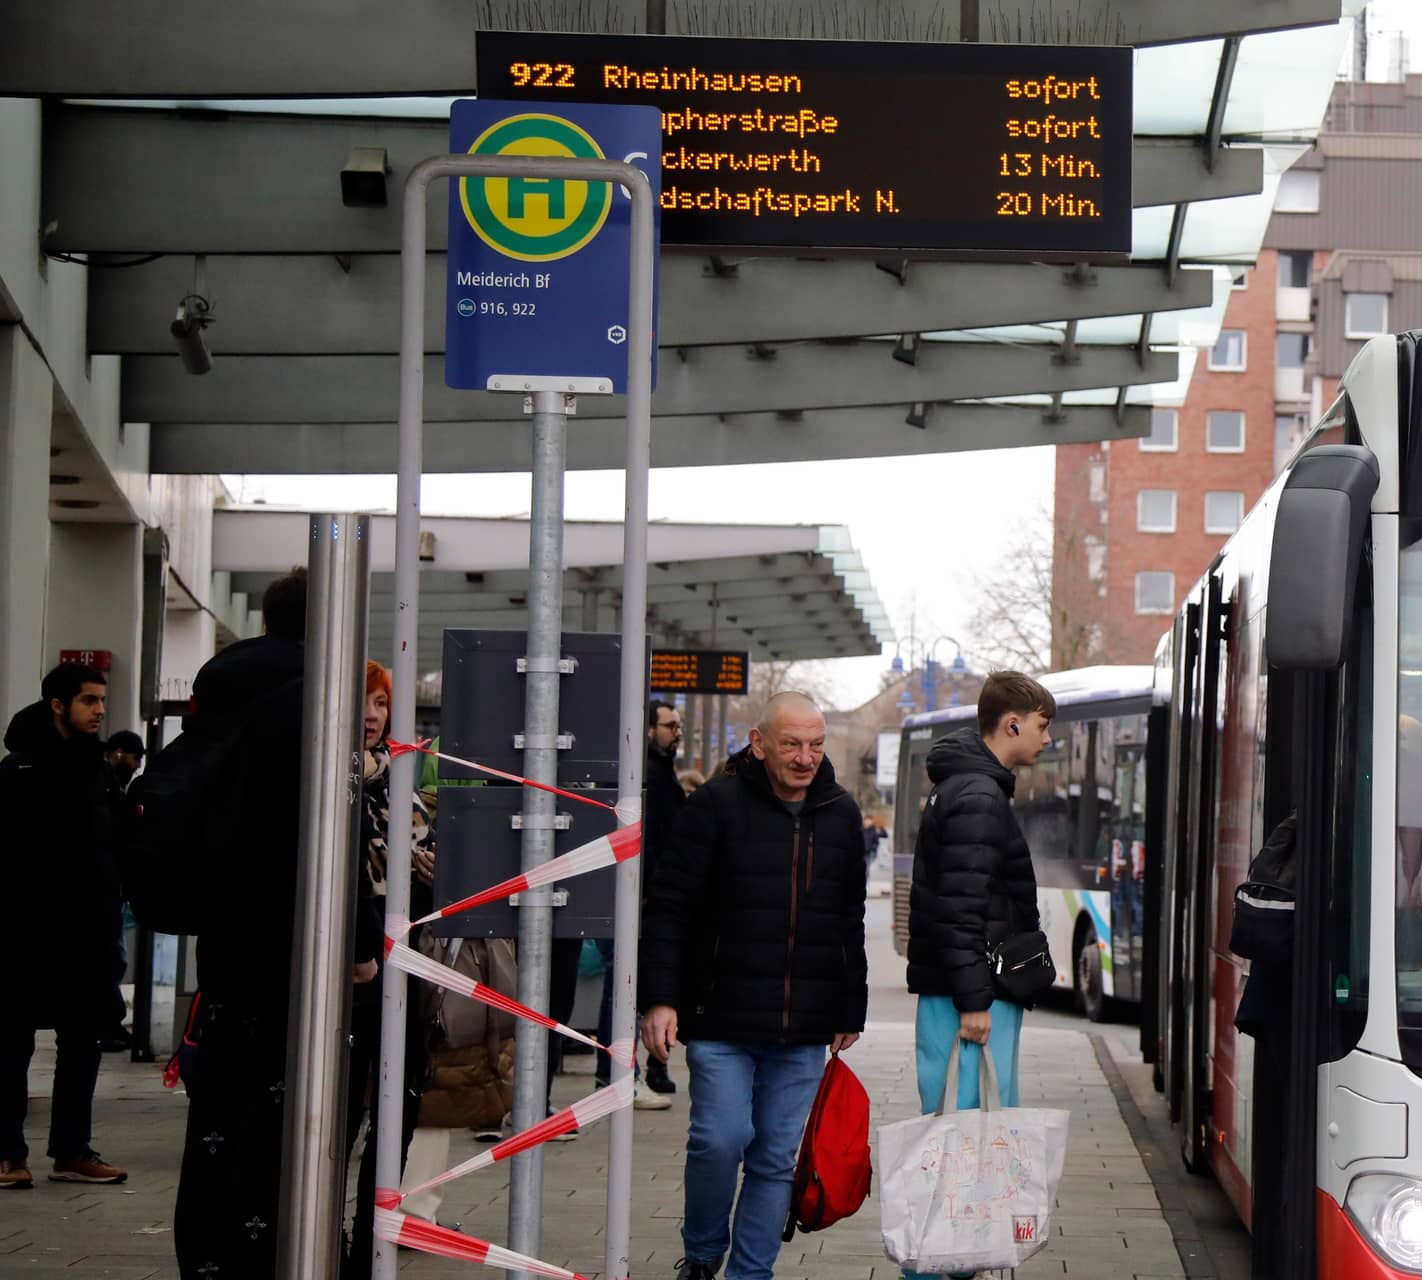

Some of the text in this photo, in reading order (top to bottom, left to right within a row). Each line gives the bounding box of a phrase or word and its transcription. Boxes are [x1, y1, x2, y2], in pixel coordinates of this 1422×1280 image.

[511, 63, 1101, 102] 922 Rheinhausen sofort
[662, 109, 1101, 142] pherstraße sofort
[662, 148, 1101, 178] ckerwerth 13 Min.
[661, 187, 1101, 217] dschaftspark N. 20 Min.
[457, 272, 550, 288] Meiderich Bf
[480, 303, 508, 316] 916,
[512, 304, 536, 316] 922
